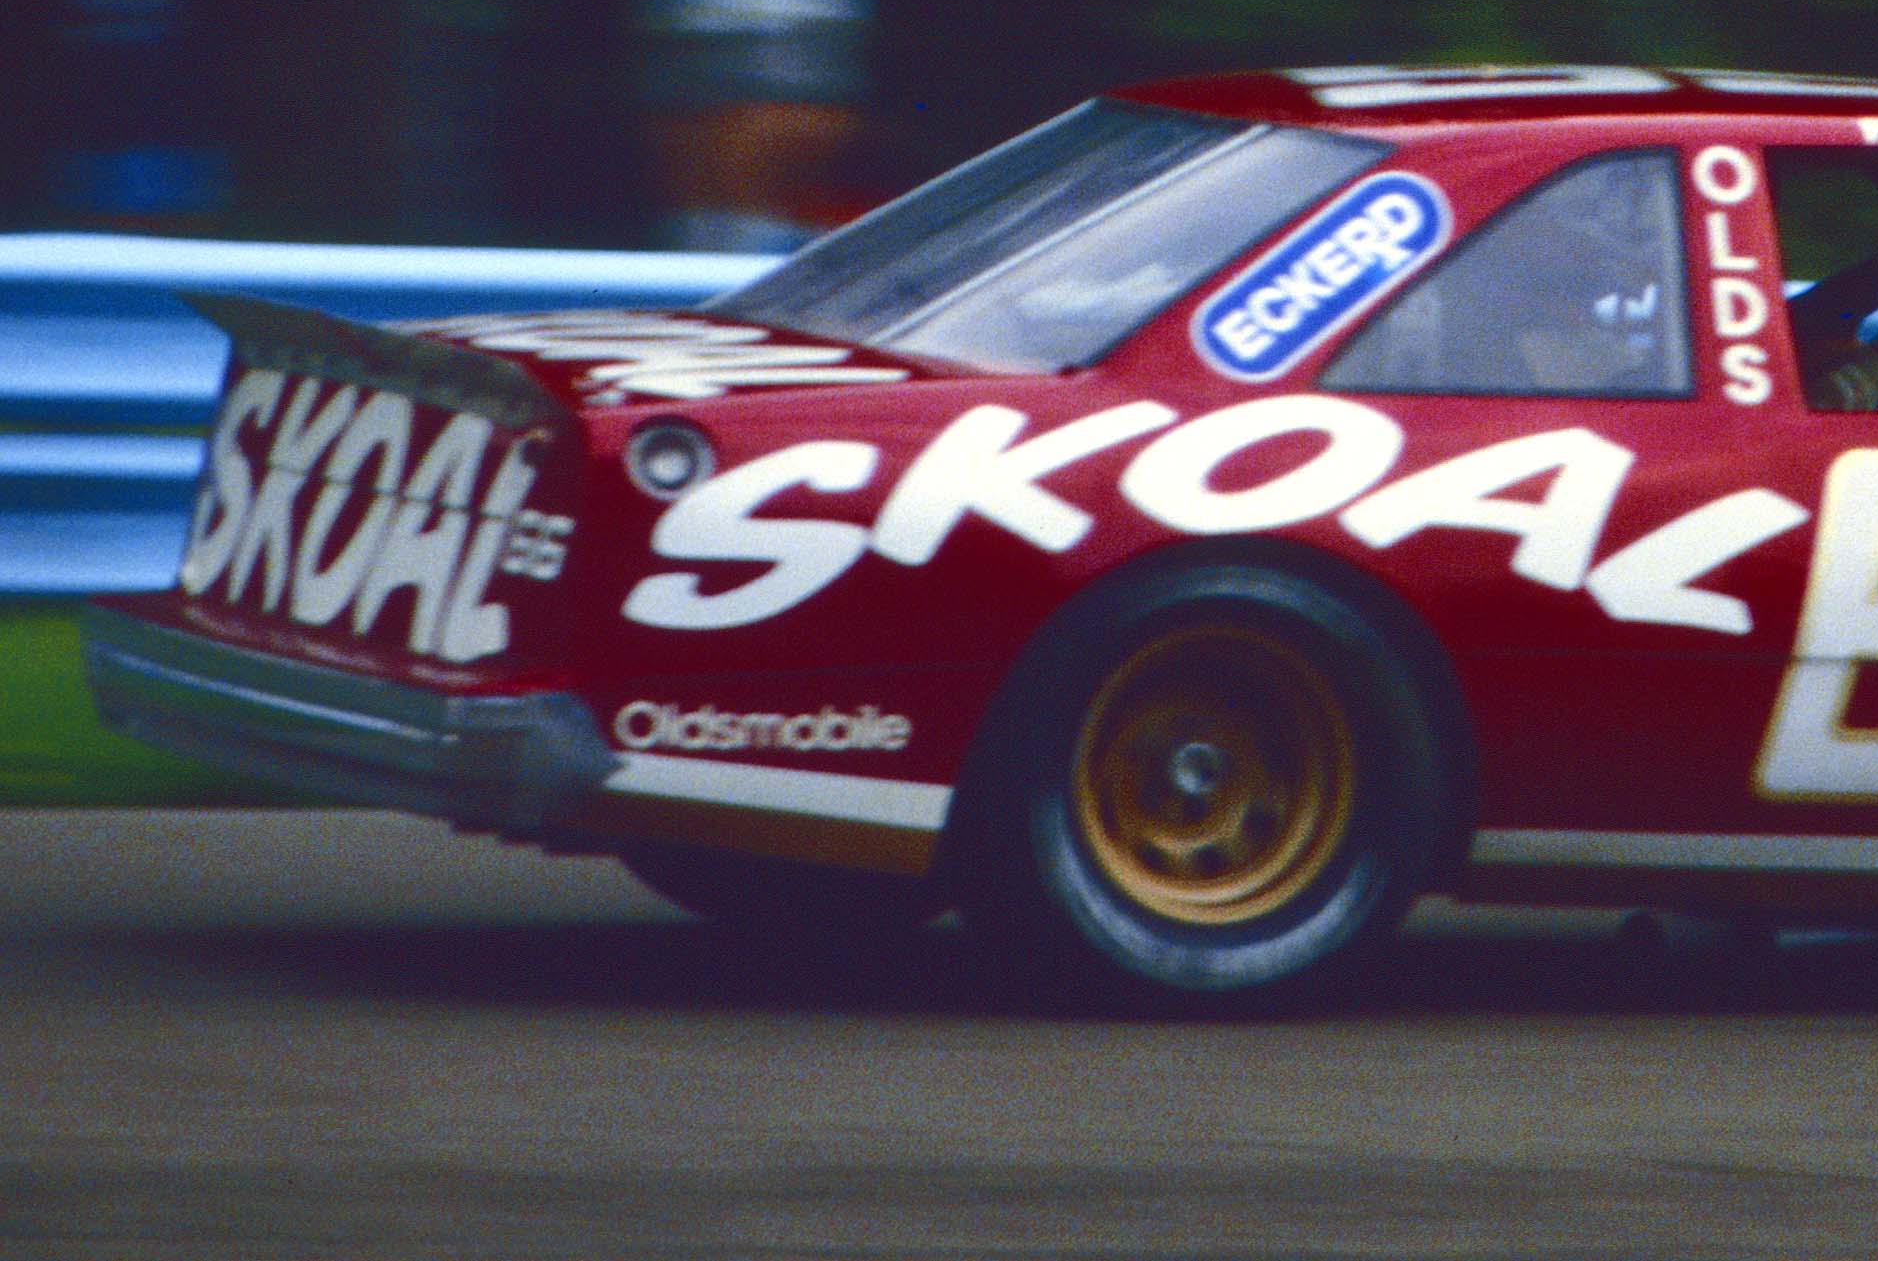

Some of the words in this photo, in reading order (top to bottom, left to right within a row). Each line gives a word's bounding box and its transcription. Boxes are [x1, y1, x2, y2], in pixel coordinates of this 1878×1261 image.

[1208, 192, 1428, 362] ECKERD
[1691, 144, 1773, 406] OLDS
[179, 366, 540, 664] SKOAL
[622, 394, 1810, 634] SKOAL
[613, 699, 912, 751] Oldsmobile
